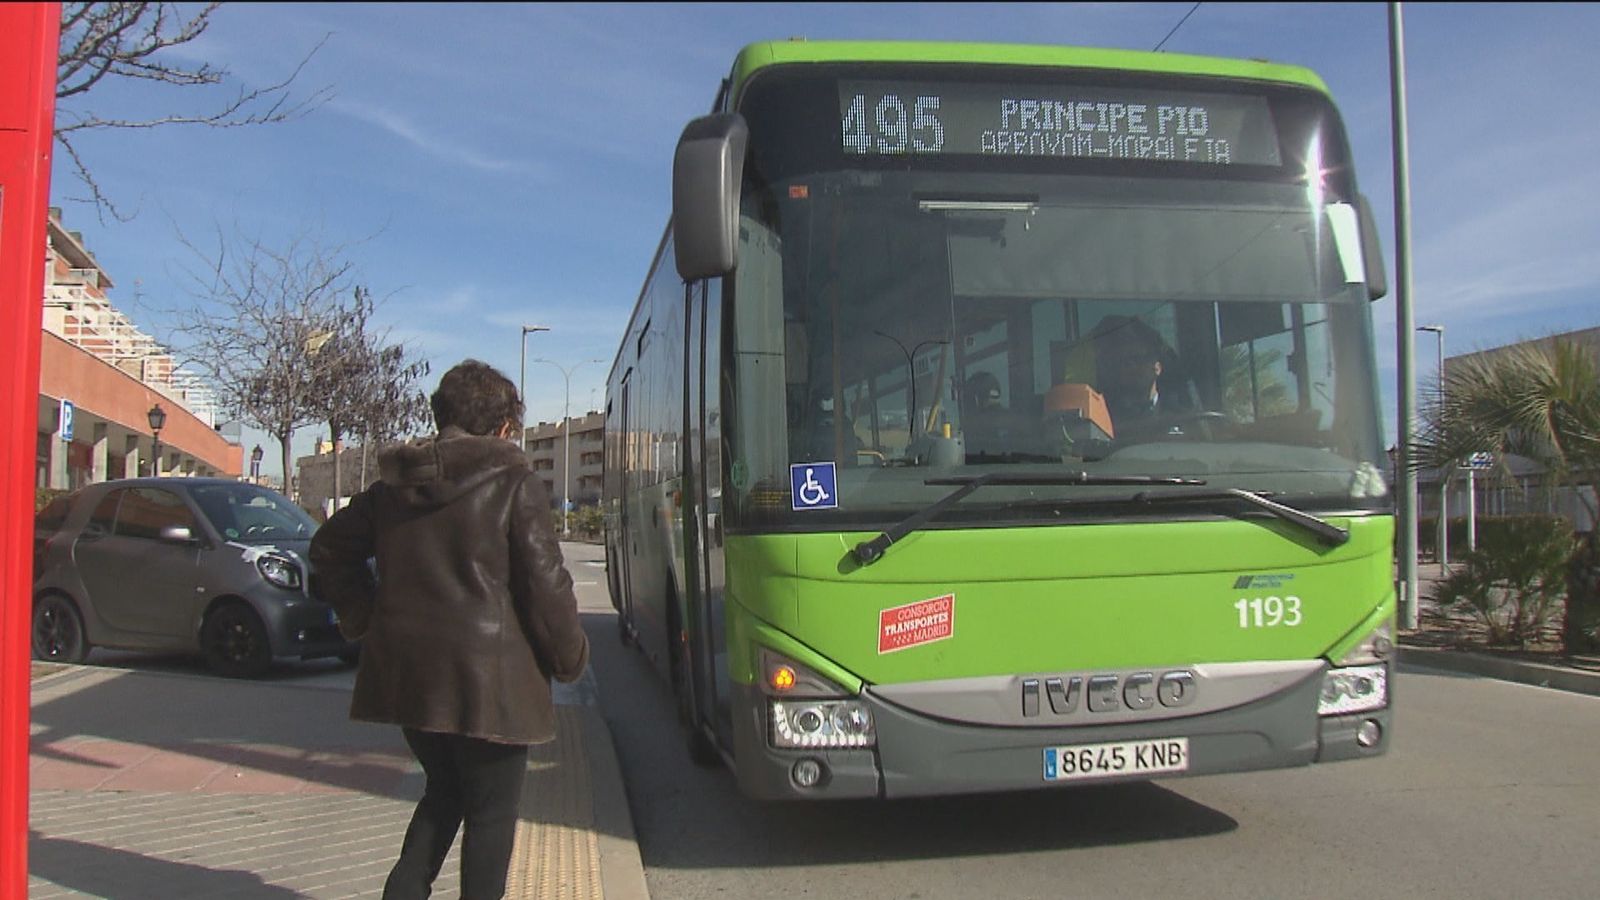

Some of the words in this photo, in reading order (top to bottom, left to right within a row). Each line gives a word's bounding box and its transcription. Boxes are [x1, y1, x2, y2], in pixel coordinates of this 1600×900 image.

[842, 94, 944, 155] 495
[1000, 99, 1148, 134] PRINCIPE
[1157, 105, 1209, 136] PIO
[64, 404, 72, 434] P
[884, 611, 949, 636] TRANSPORTES
[897, 599, 950, 621] CONSORCIO
[1234, 595, 1302, 628] 1193
[913, 623, 949, 642] MADRID
[1022, 670, 1197, 718] IVECO
[1062, 747, 1126, 775] 8645
[1135, 742, 1182, 769] KNB
